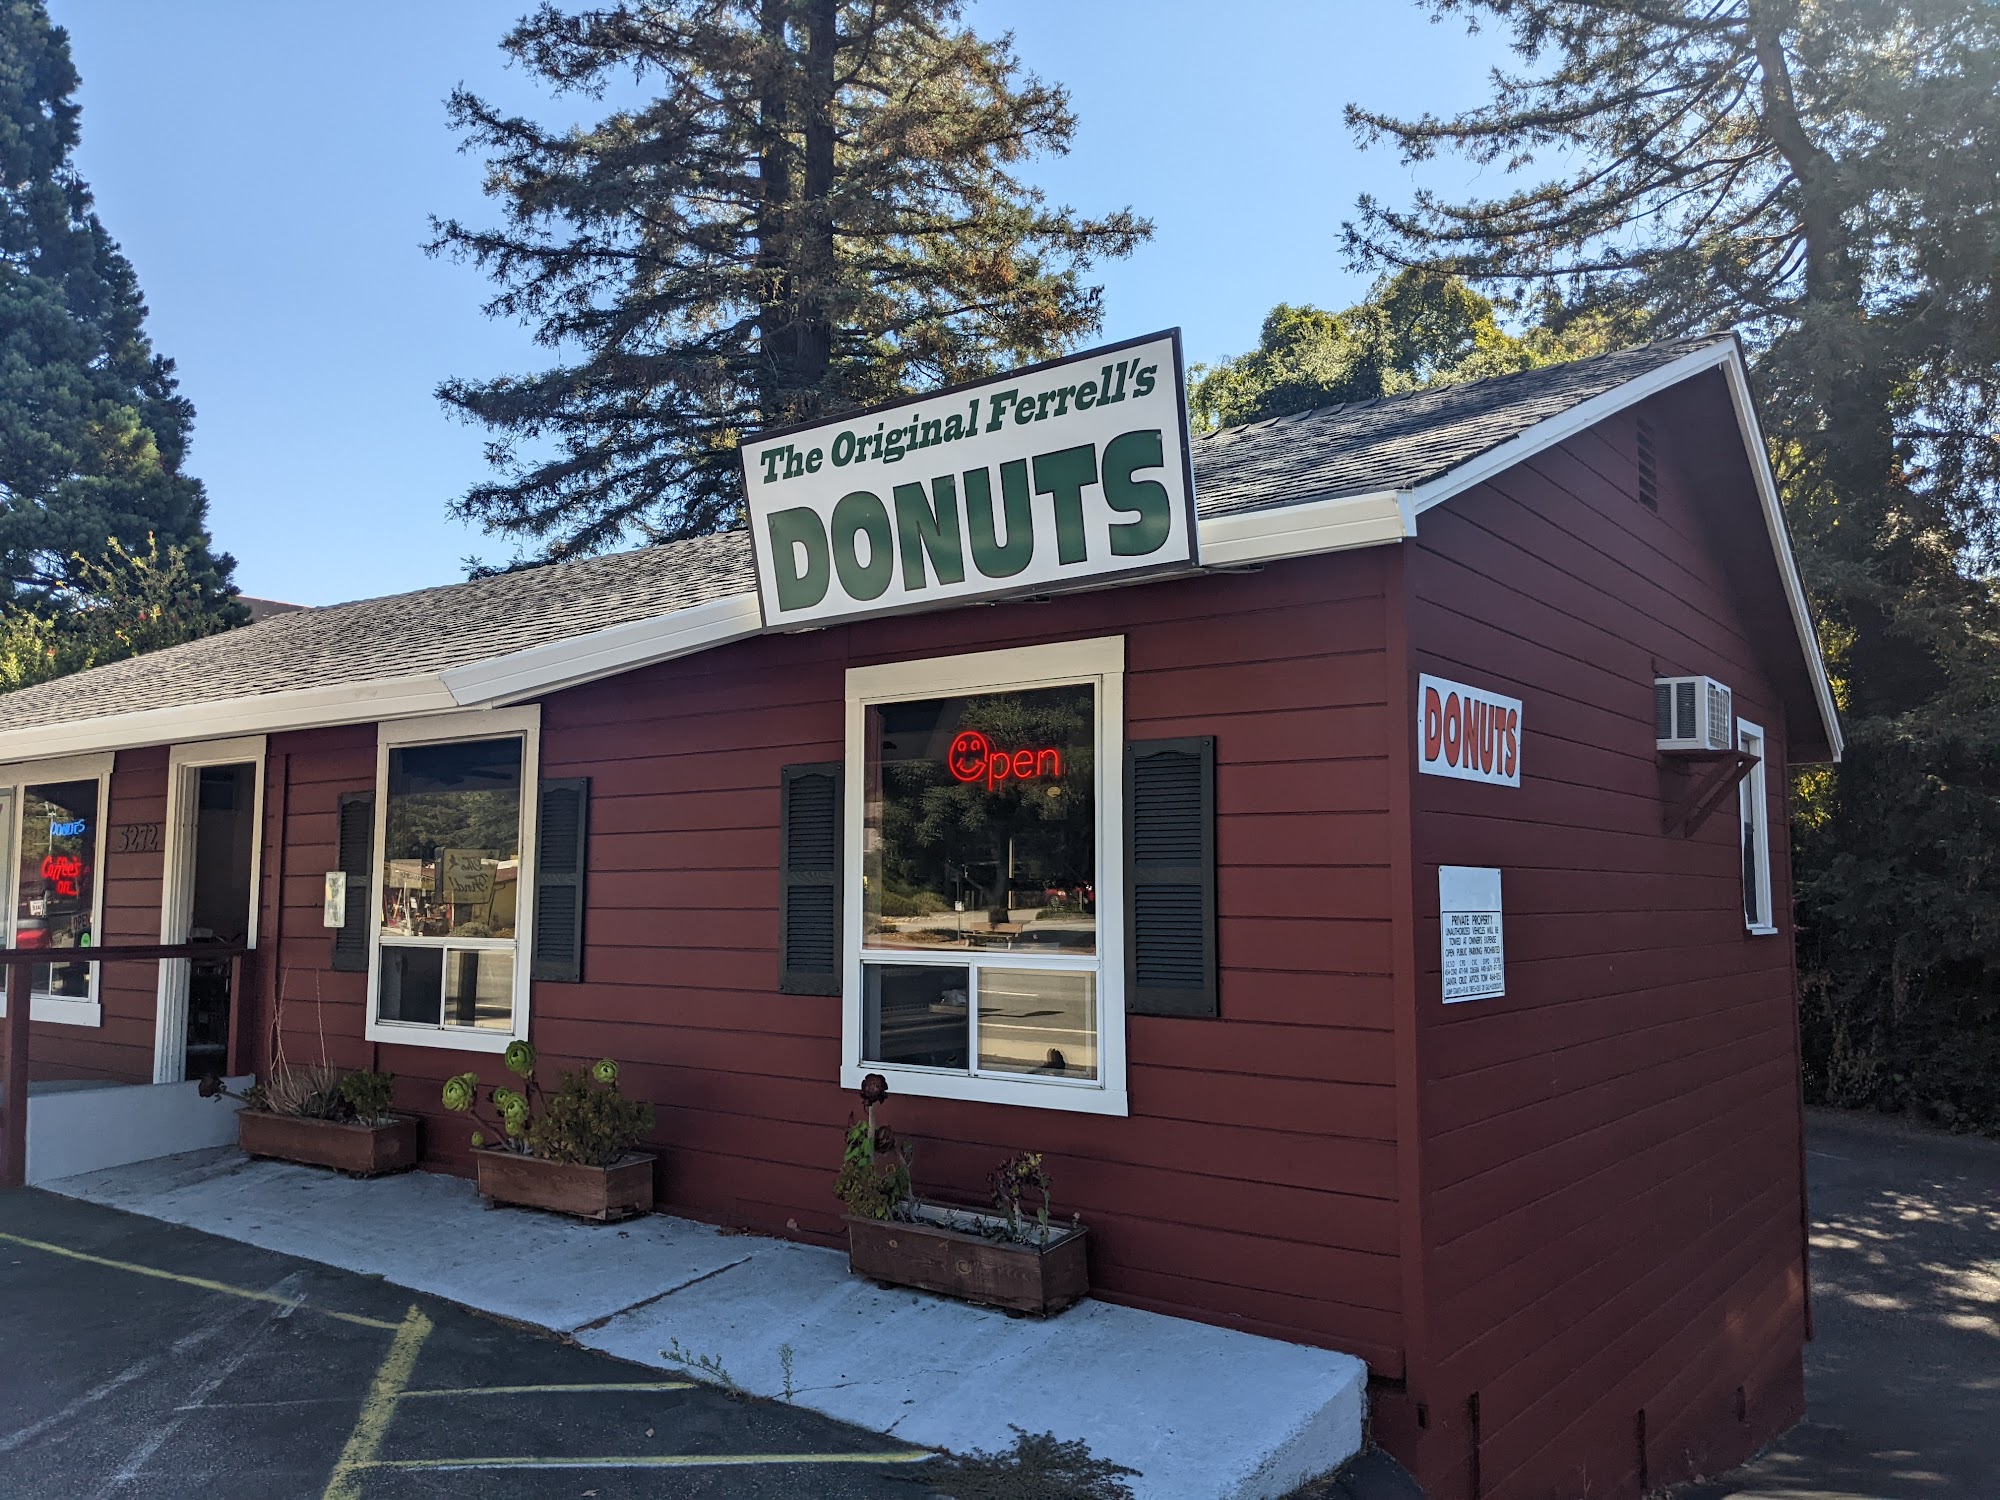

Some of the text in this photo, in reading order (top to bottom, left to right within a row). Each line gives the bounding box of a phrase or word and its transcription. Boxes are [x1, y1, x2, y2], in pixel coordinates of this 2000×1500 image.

[760, 358, 1158, 485] The Original Ferrell's
[767, 429, 1171, 612] DONUTS
[1425, 686, 1517, 778] DONUTS
[1452, 915, 1493, 926] PRIVATE PROPERTY
